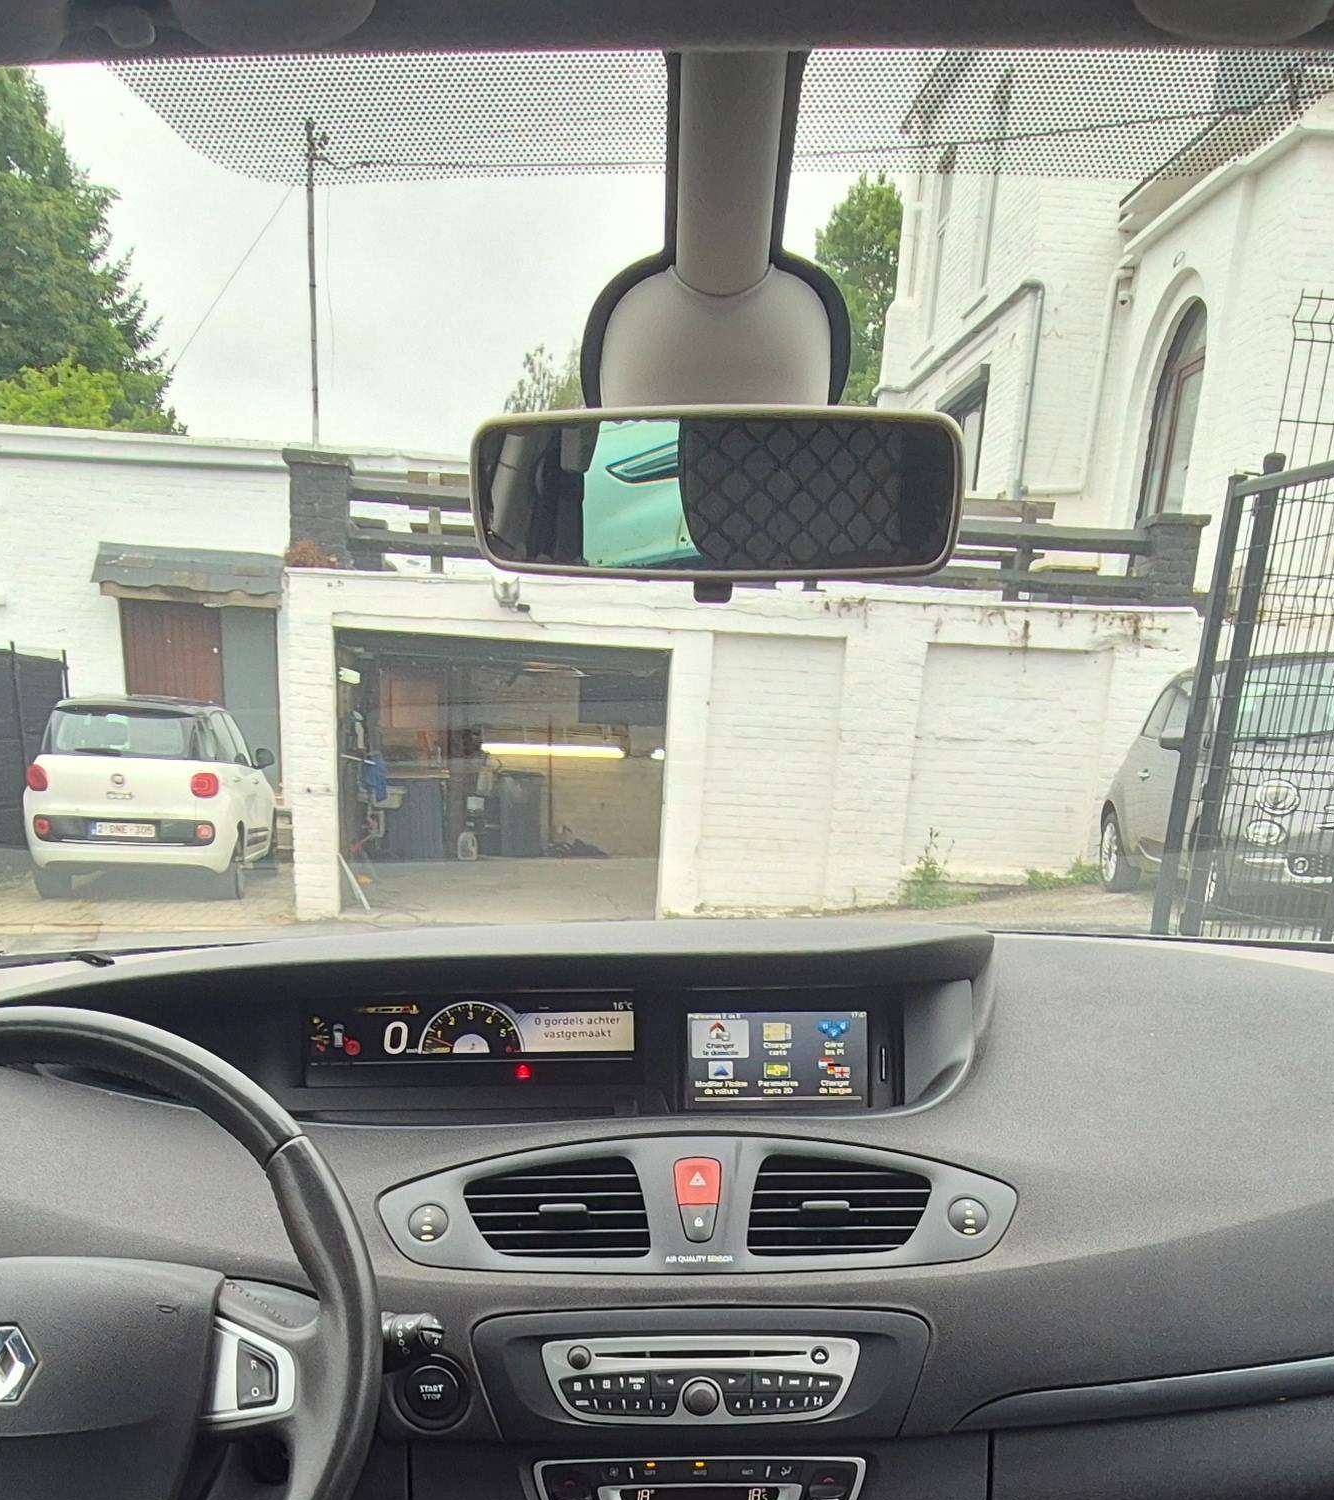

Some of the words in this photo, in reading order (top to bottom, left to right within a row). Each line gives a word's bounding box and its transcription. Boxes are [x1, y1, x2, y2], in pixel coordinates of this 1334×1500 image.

[586, 1016, 620, 1025] achter
[383, 1020, 409, 1055] 0
[543, 1029, 612, 1040] vastgemaakt
[666, 1255, 677, 1263] AIR
[677, 1255, 707, 1263] QUALITY
[707, 1255, 734, 1263] SENSOR
[250, 1359, 258, 1370] R
[419, 1384, 443, 1393] START
